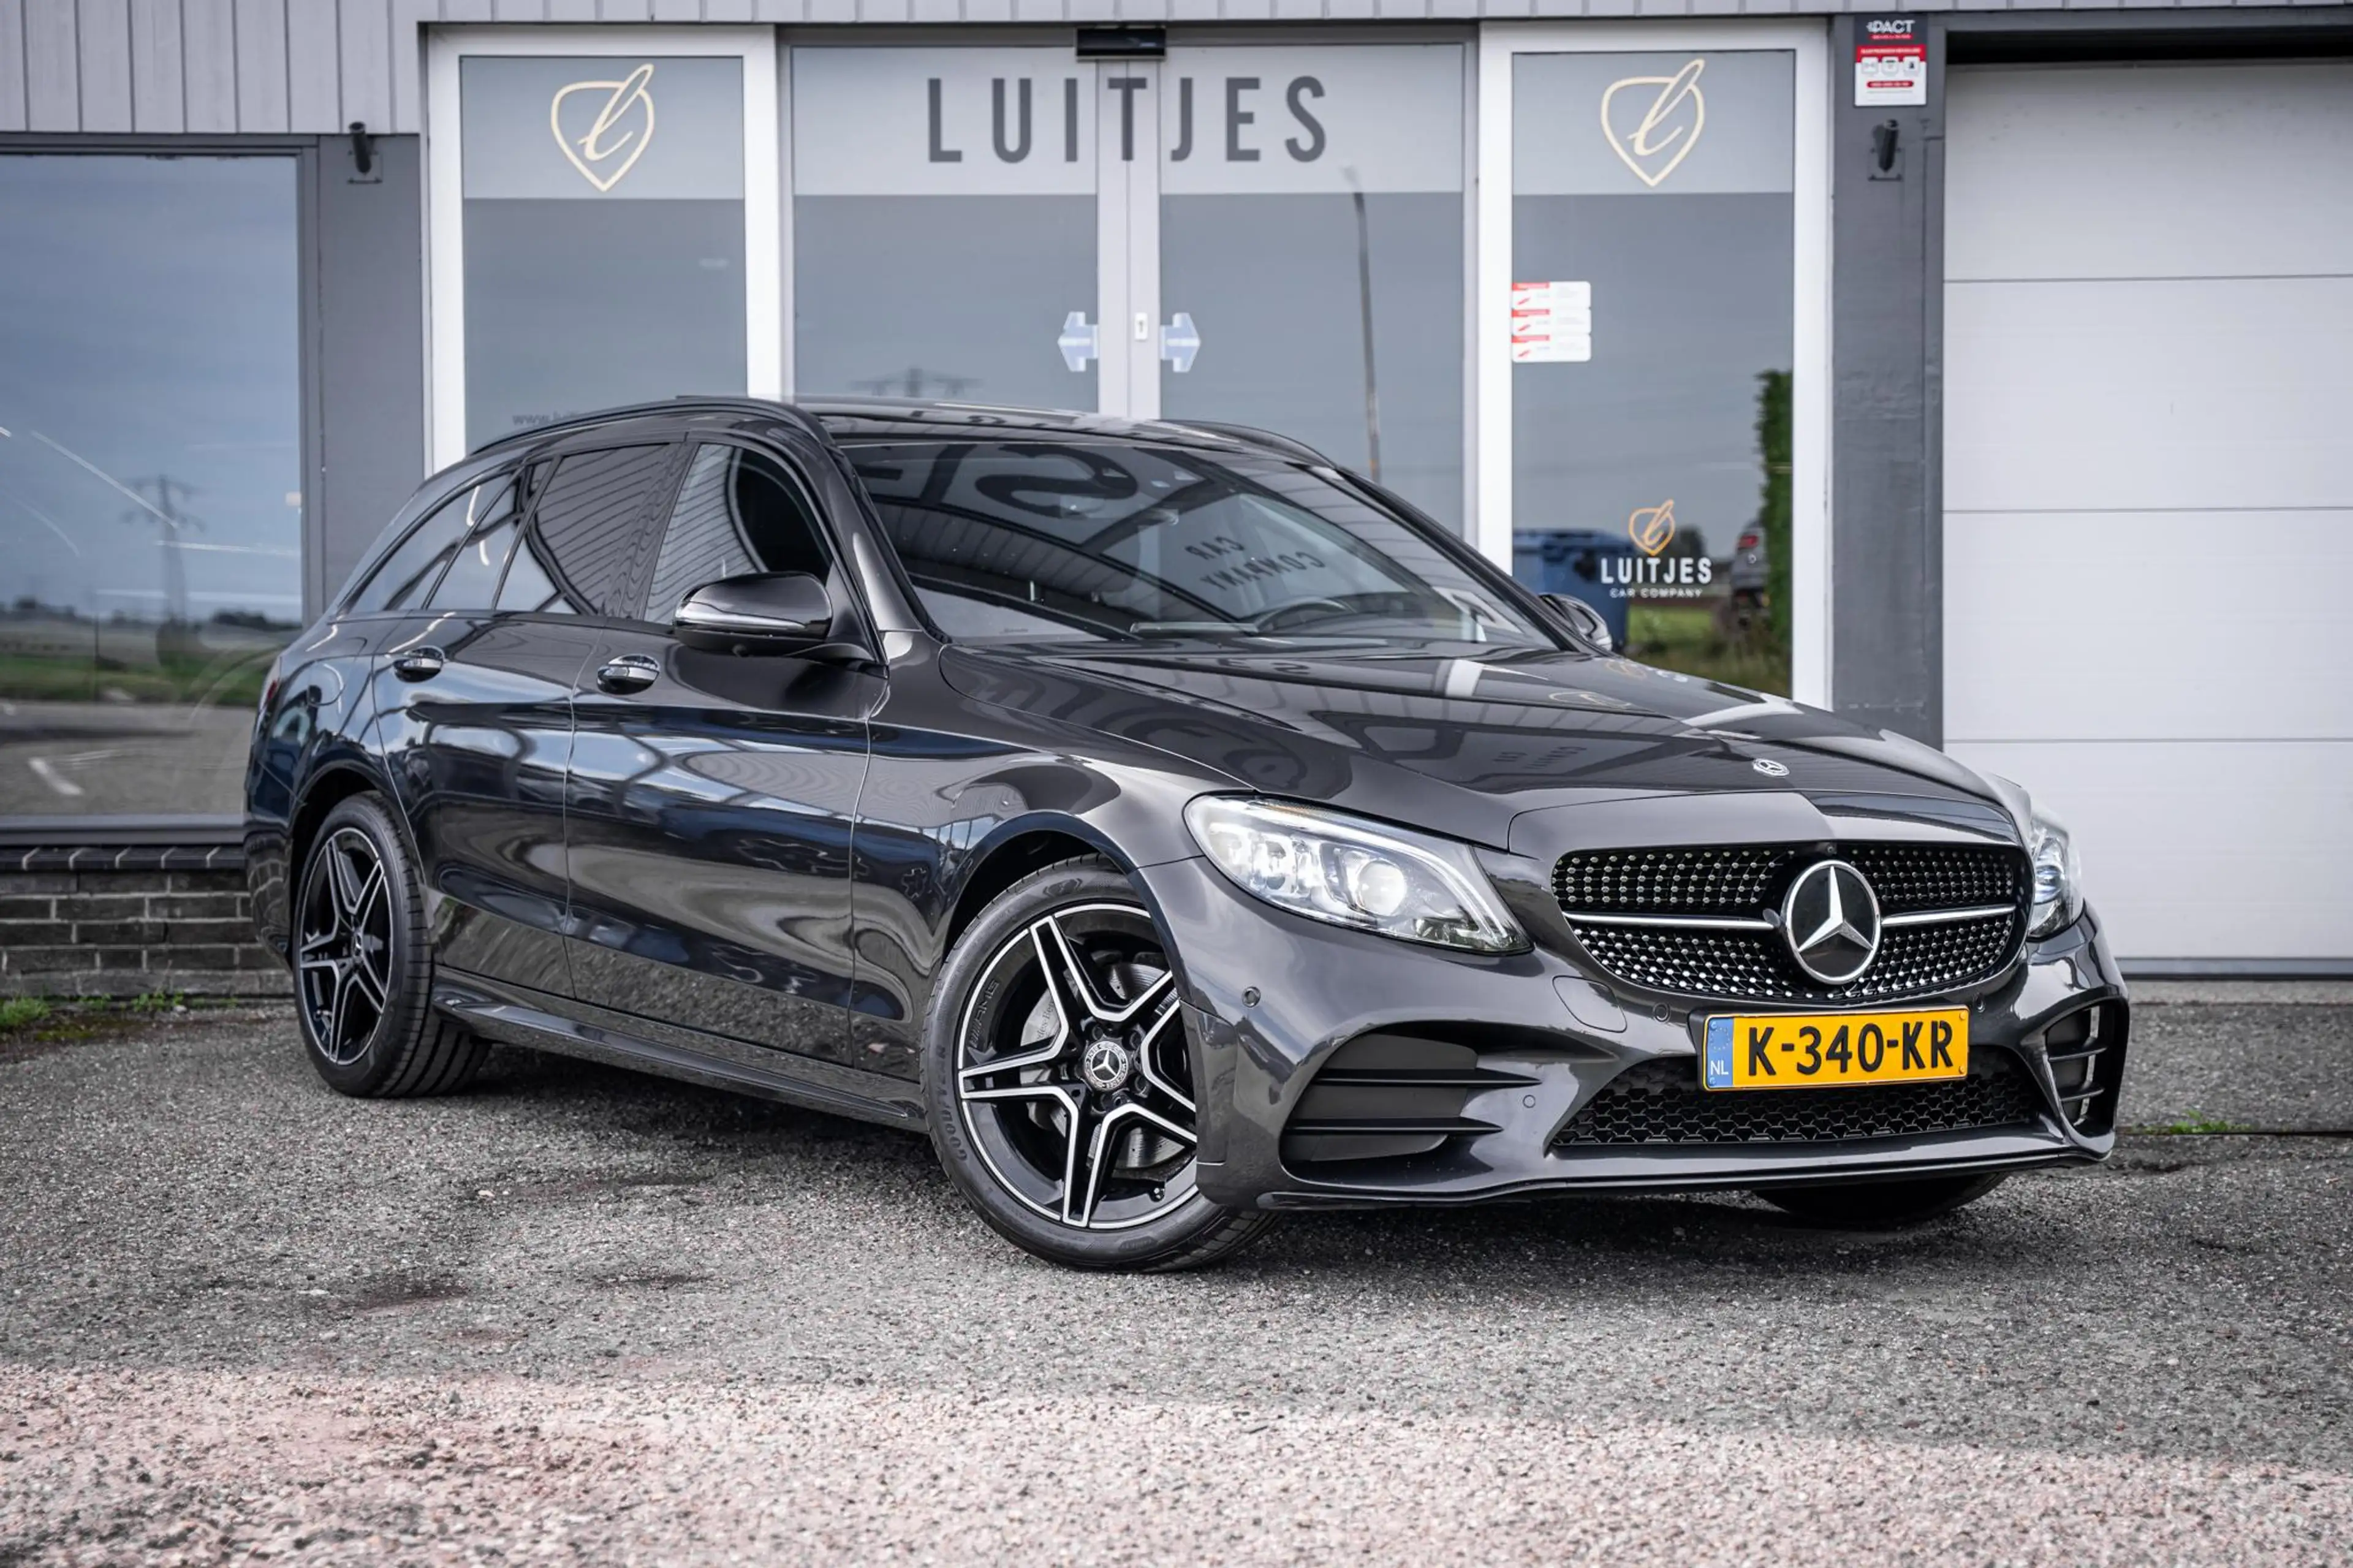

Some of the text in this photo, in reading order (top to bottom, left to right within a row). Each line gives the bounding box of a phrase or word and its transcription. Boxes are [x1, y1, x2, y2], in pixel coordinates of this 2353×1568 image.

[927, 76, 1327, 163] LUITJES
[1601, 557, 1712, 584] LUITJES
[1609, 588, 1703, 598] CAR COMPANY
[1710, 1020, 1954, 1077] NL K-340-KR
